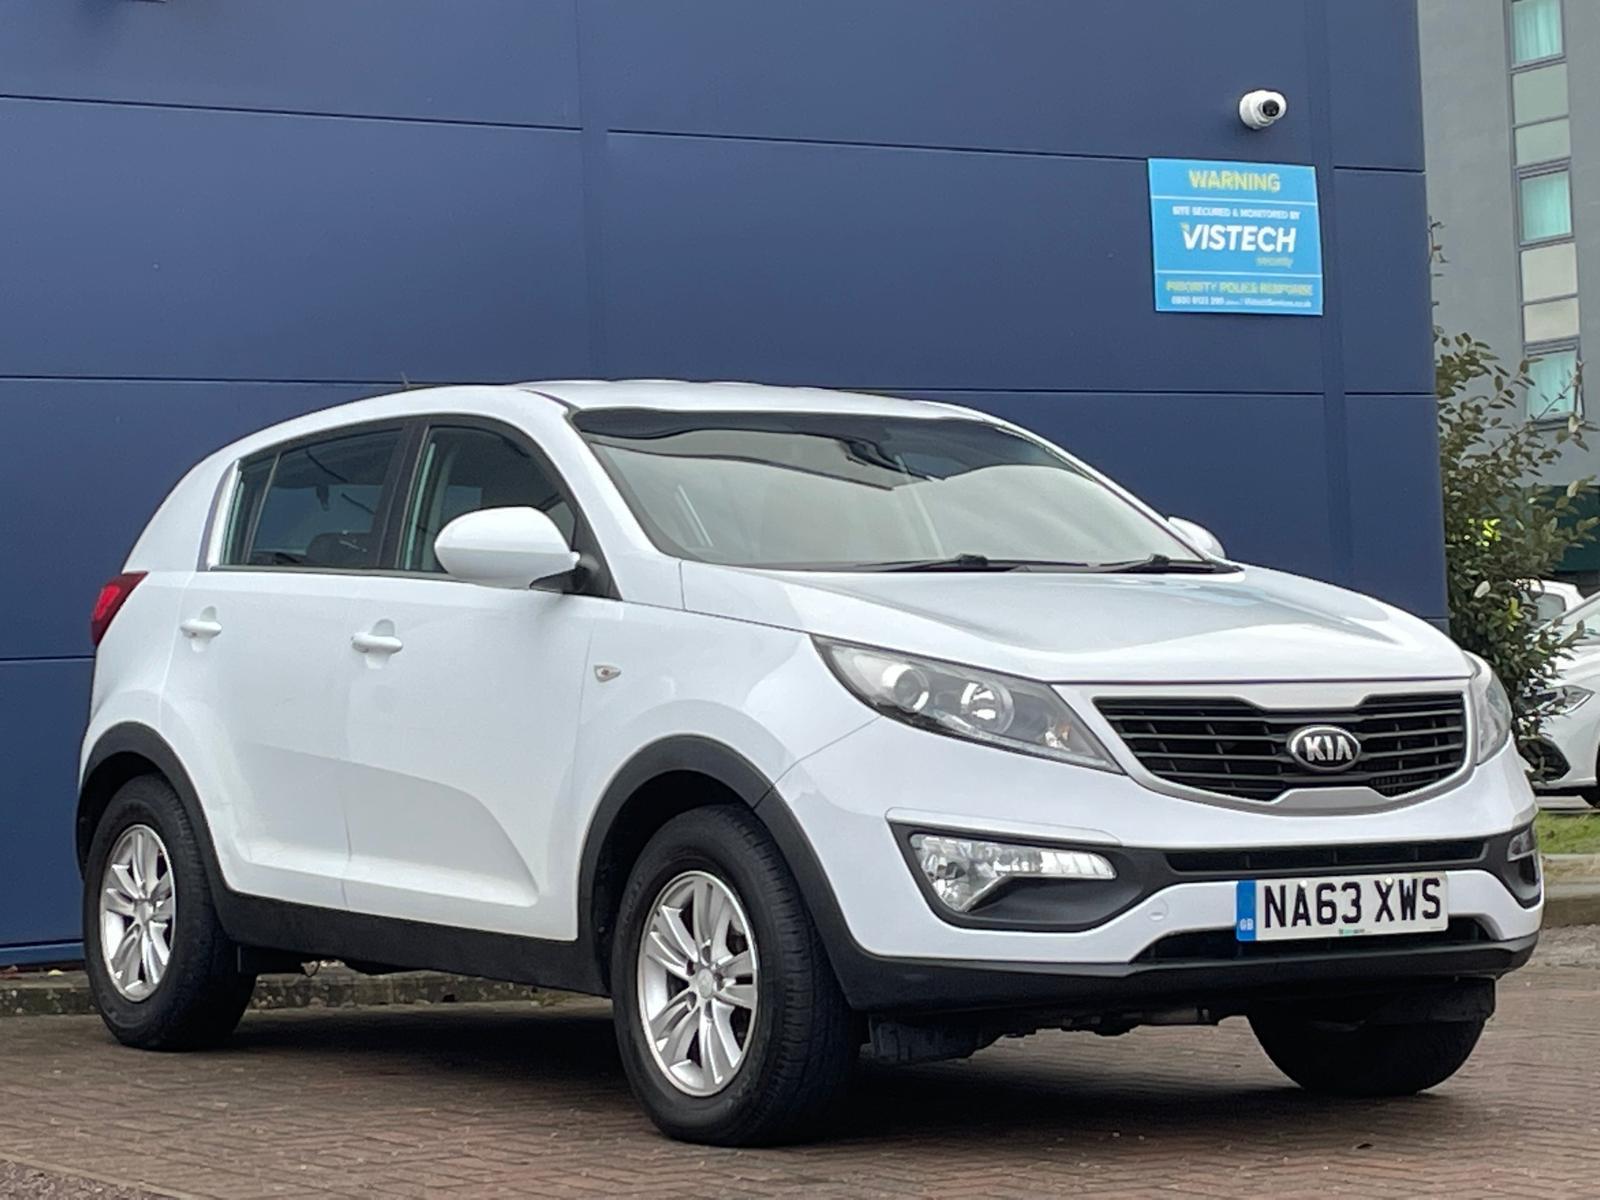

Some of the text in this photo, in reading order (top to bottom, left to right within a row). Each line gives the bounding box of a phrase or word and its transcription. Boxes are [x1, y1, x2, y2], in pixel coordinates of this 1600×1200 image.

[1188, 169, 1281, 192] WARNING
[1192, 206, 1231, 217] SECURED
[1240, 208, 1289, 220] MONITORED
[1181, 222, 1297, 253] VISTECH
[1304, 735, 1353, 761] KIA
[1264, 877, 1441, 928] NA63 XWS
